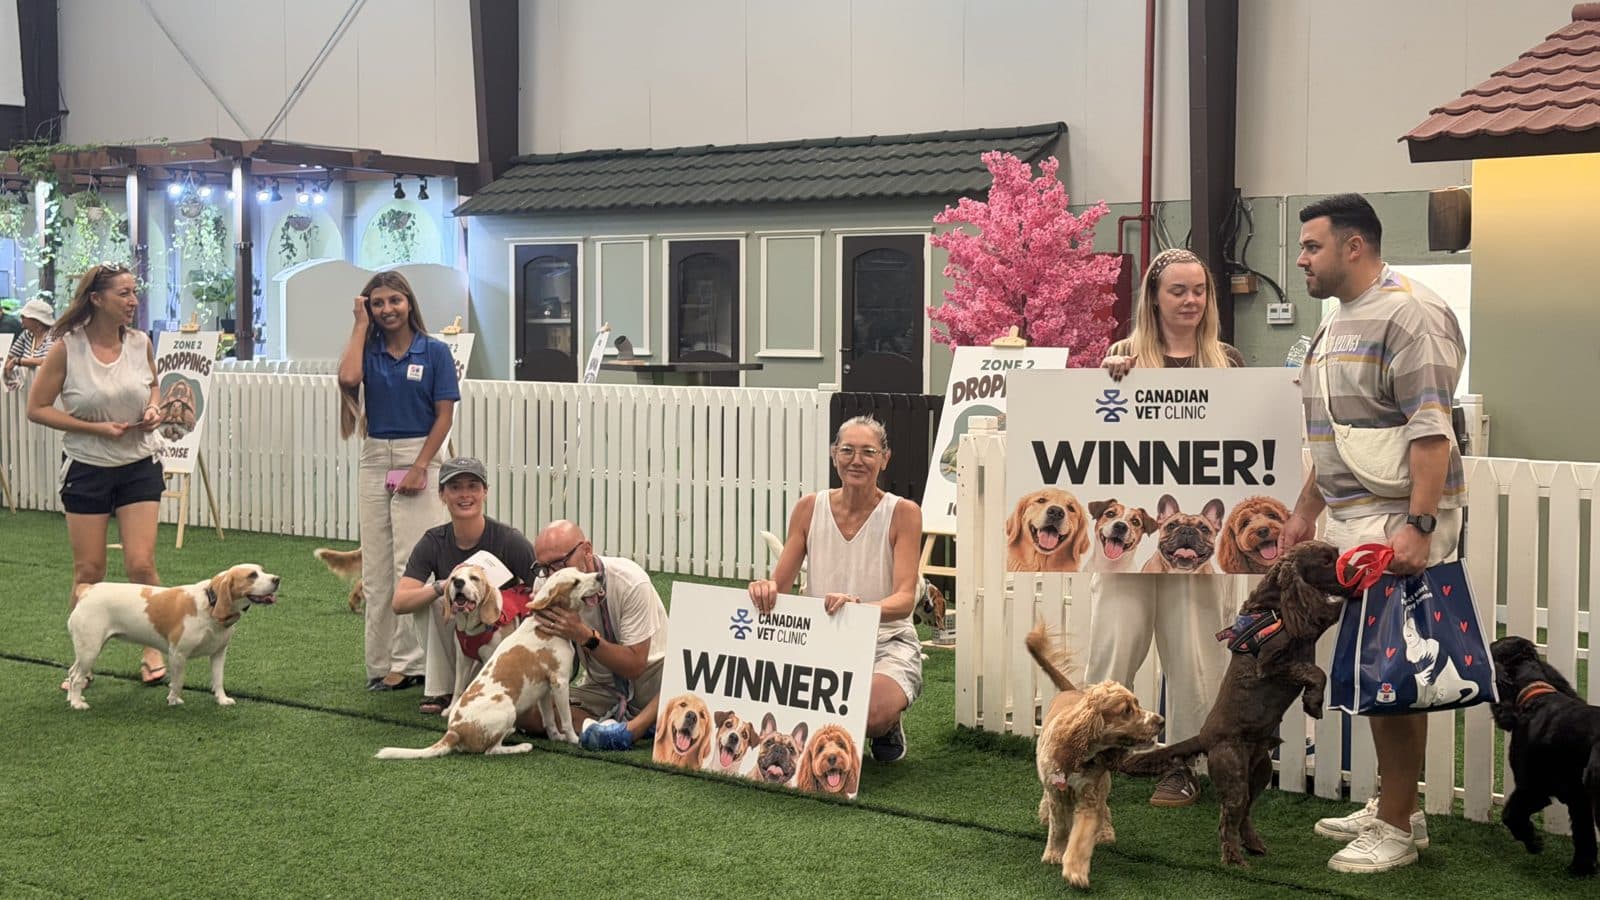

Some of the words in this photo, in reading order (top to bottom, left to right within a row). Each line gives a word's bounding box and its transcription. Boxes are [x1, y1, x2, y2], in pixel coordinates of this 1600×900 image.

[173, 340, 195, 349] ZONE
[197, 340, 202, 349] 2
[157, 352, 212, 376] DROPPINGS
[980, 359, 1023, 371] ZONE
[1025, 359, 1035, 369] 2
[1135, 388, 1209, 403] CANADIAN
[1135, 405, 1161, 420] VET
[1164, 405, 1206, 420] CLINIC
[1031, 439, 1277, 486] WINNER!
[758, 613, 811, 630] CANADIAN
[757, 627, 775, 640] VET
[776, 629, 807, 645] CLINIC
[682, 648, 853, 717] WINNER!
